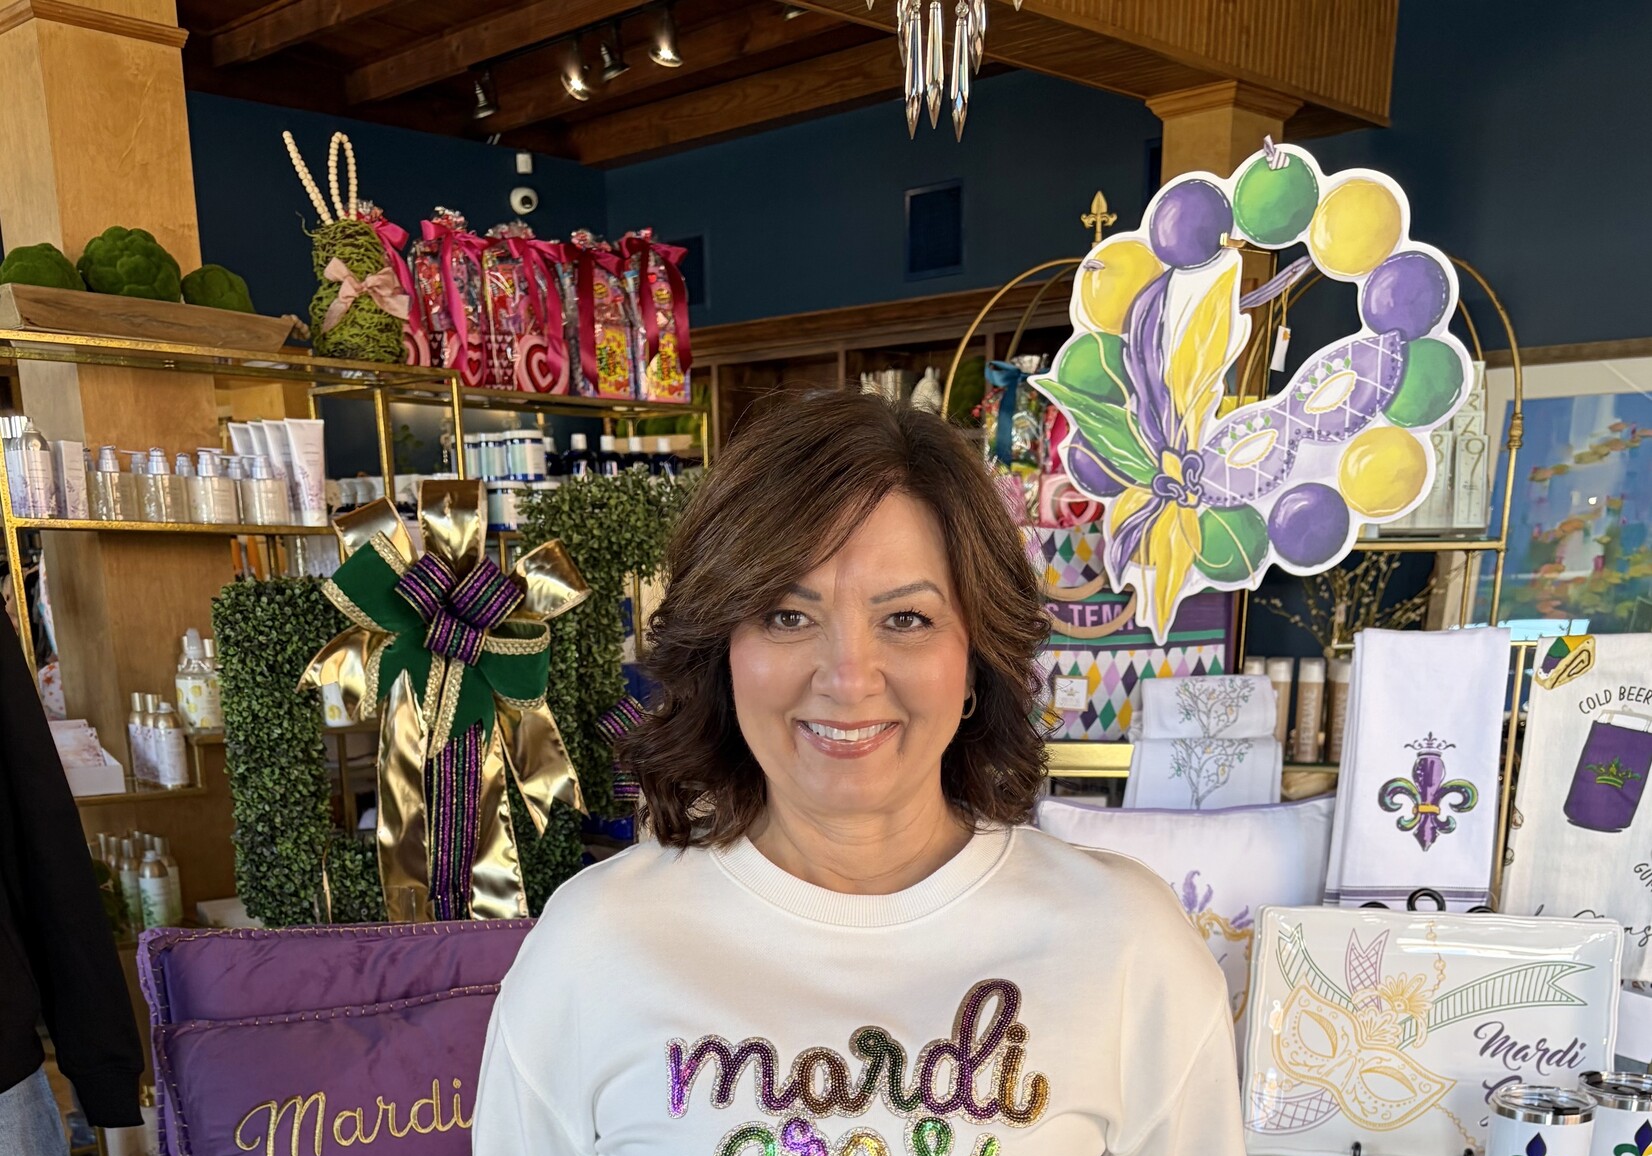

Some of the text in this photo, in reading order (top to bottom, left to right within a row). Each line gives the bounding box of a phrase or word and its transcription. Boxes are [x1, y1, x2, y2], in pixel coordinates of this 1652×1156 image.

[1465, 438, 1485, 504] 9
[1068, 604, 1134, 631] TEM
[1578, 685, 1652, 714] COLD BEER
[665, 978, 1051, 1129] mardi
[1473, 1021, 1587, 1077] Mardi
